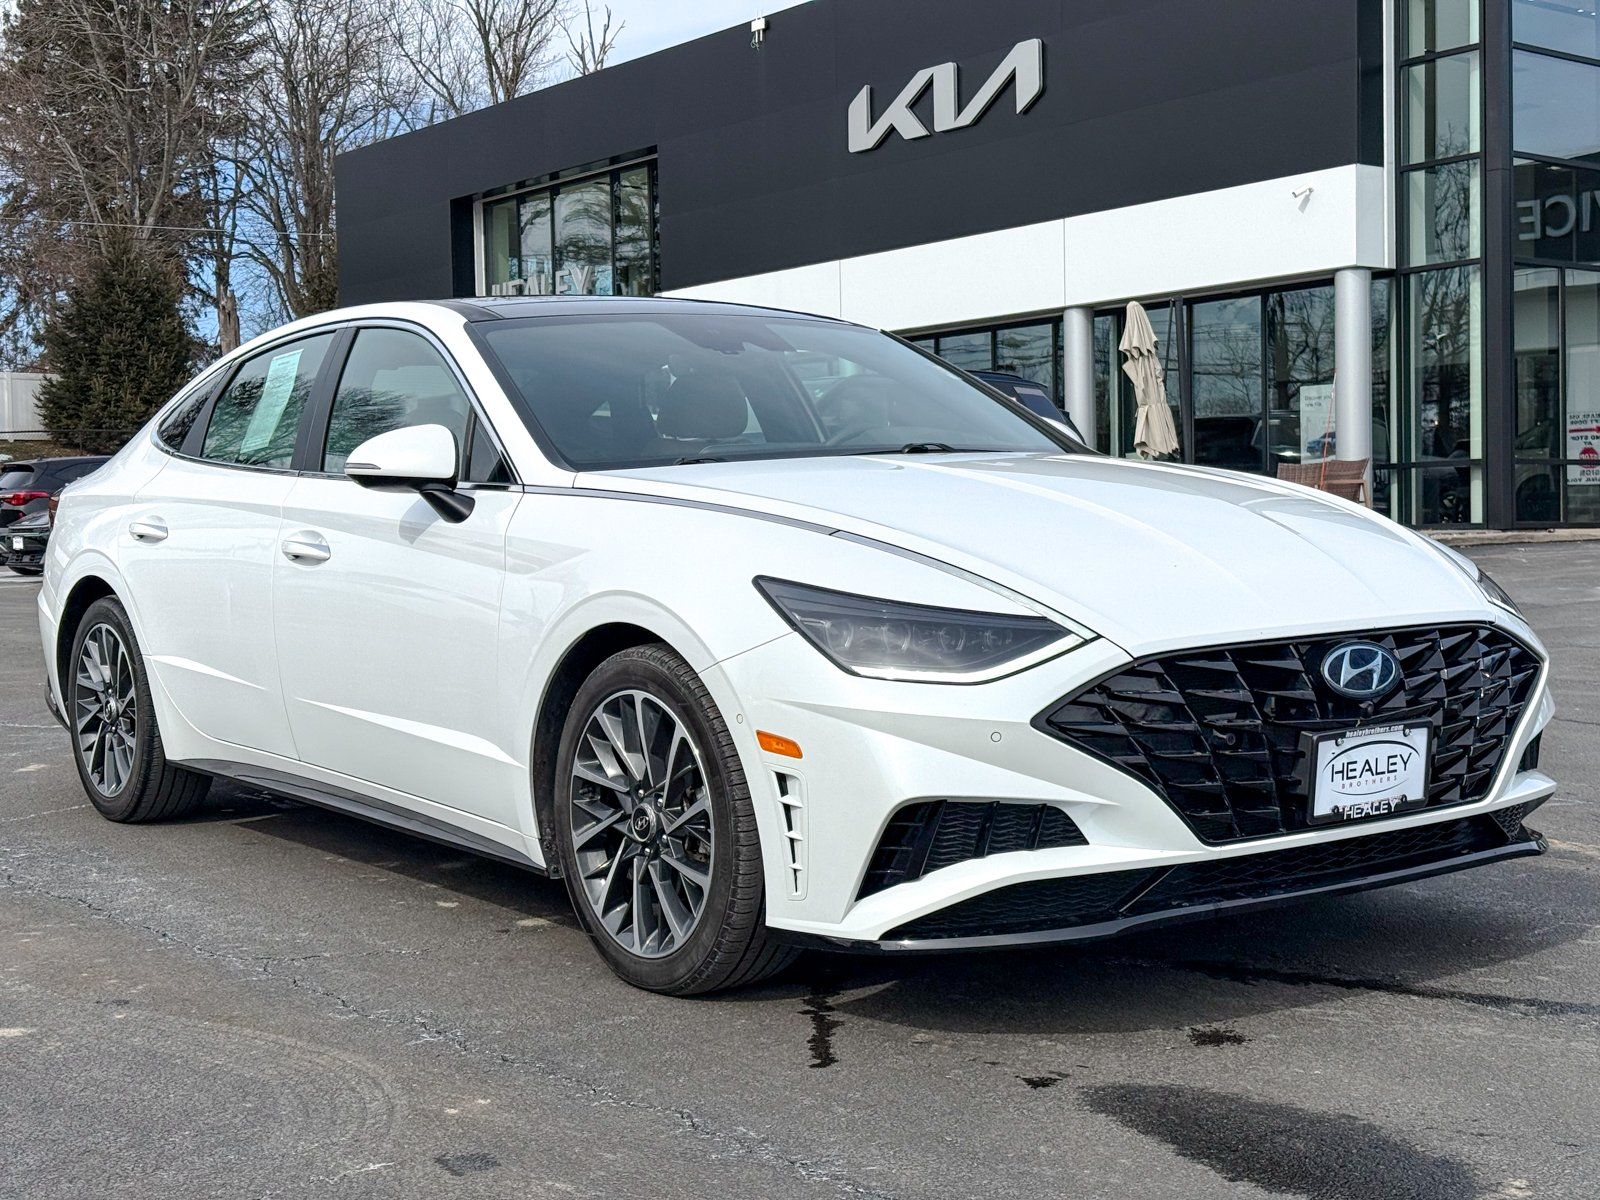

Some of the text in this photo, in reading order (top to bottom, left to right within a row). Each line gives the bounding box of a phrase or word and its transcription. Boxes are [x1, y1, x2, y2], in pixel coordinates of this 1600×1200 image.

[848, 38, 1043, 153] KIA
[1345, 724, 1405, 738] healeybrothers.com
[1331, 752, 1413, 783] HEALEY
[1341, 775, 1397, 790] BROTHERS
[1343, 799, 1398, 820] HEALEY
